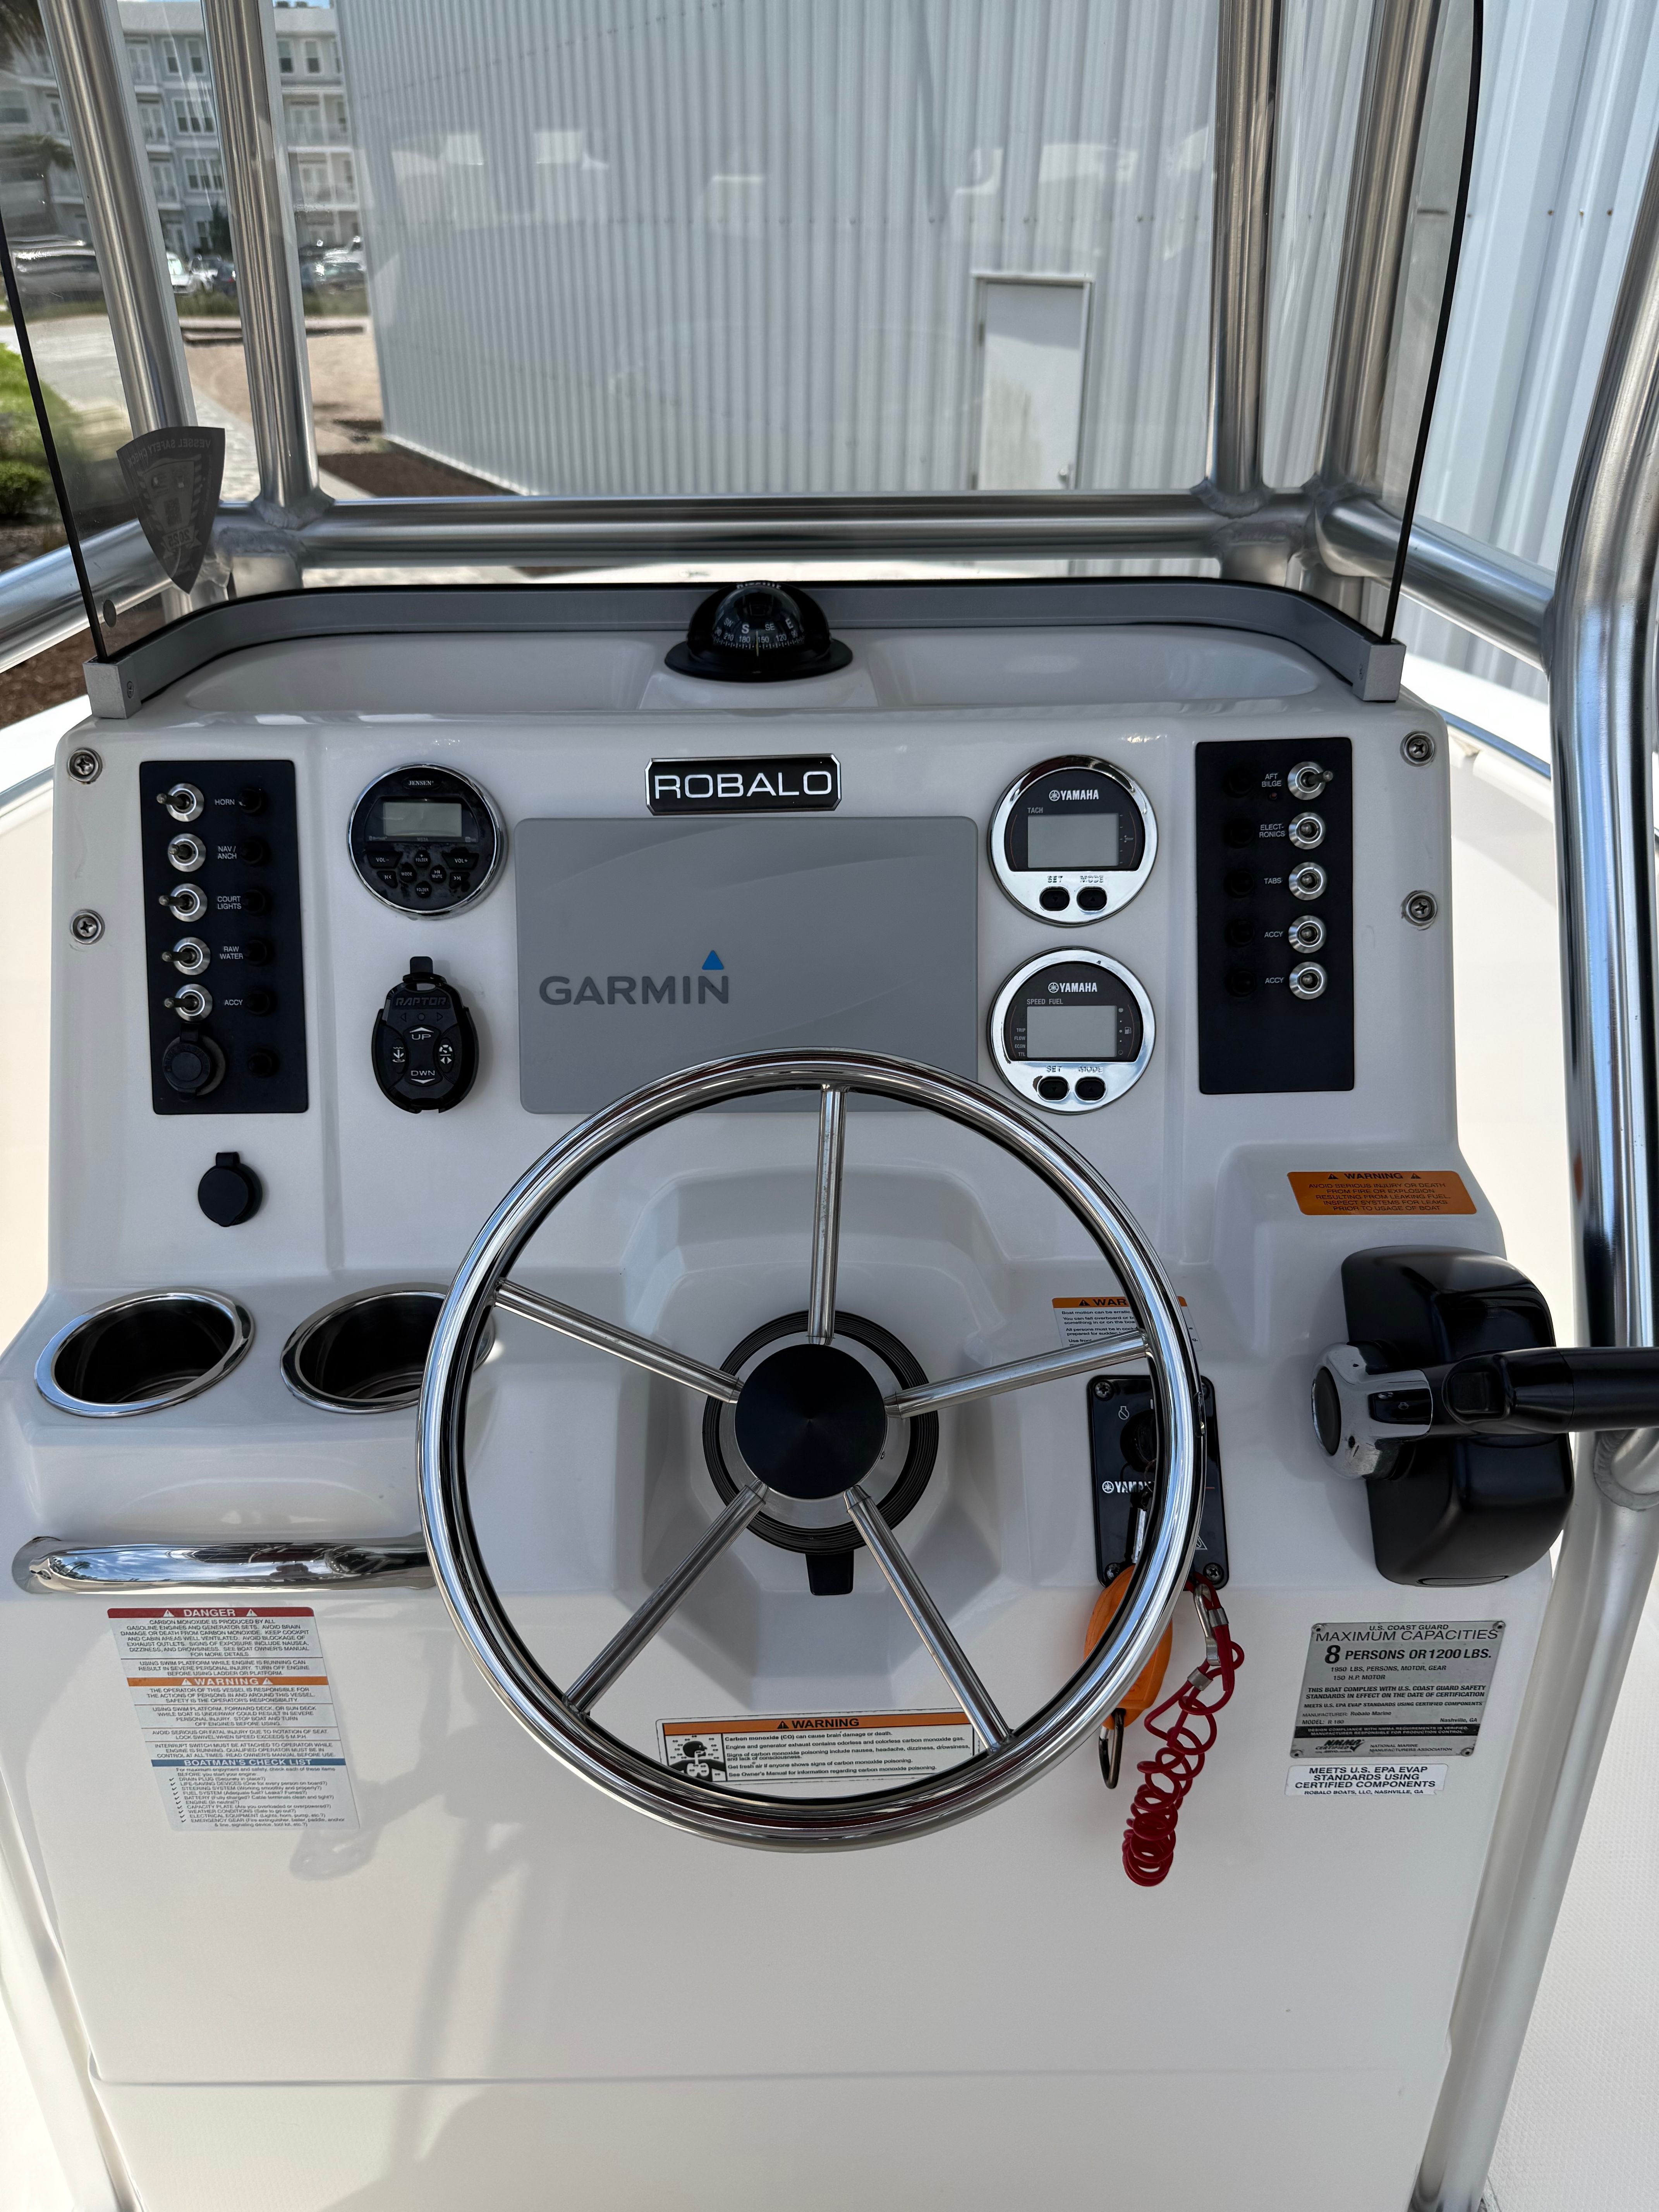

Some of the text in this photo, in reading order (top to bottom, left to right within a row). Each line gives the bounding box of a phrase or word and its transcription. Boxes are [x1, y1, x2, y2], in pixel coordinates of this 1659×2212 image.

[742, 624, 749, 633] S
[785, 619, 793, 629] E
[654, 771, 832, 799] ROBALO
[1060, 790, 1099, 800] YAMAHA
[539, 976, 728, 1005] GARMIN
[1060, 982, 1097, 993] YAMAHA
[396, 997, 447, 1006] RAPTOR
[1114, 1481, 1154, 1493] YAMA
[1316, 1630, 1498, 1642] MAXIMUM CAPACITIES
[1324, 1645, 1491, 1664] 8 PERSONS OR 1200 LBS.
[792, 1718, 859, 1729] WARNING
